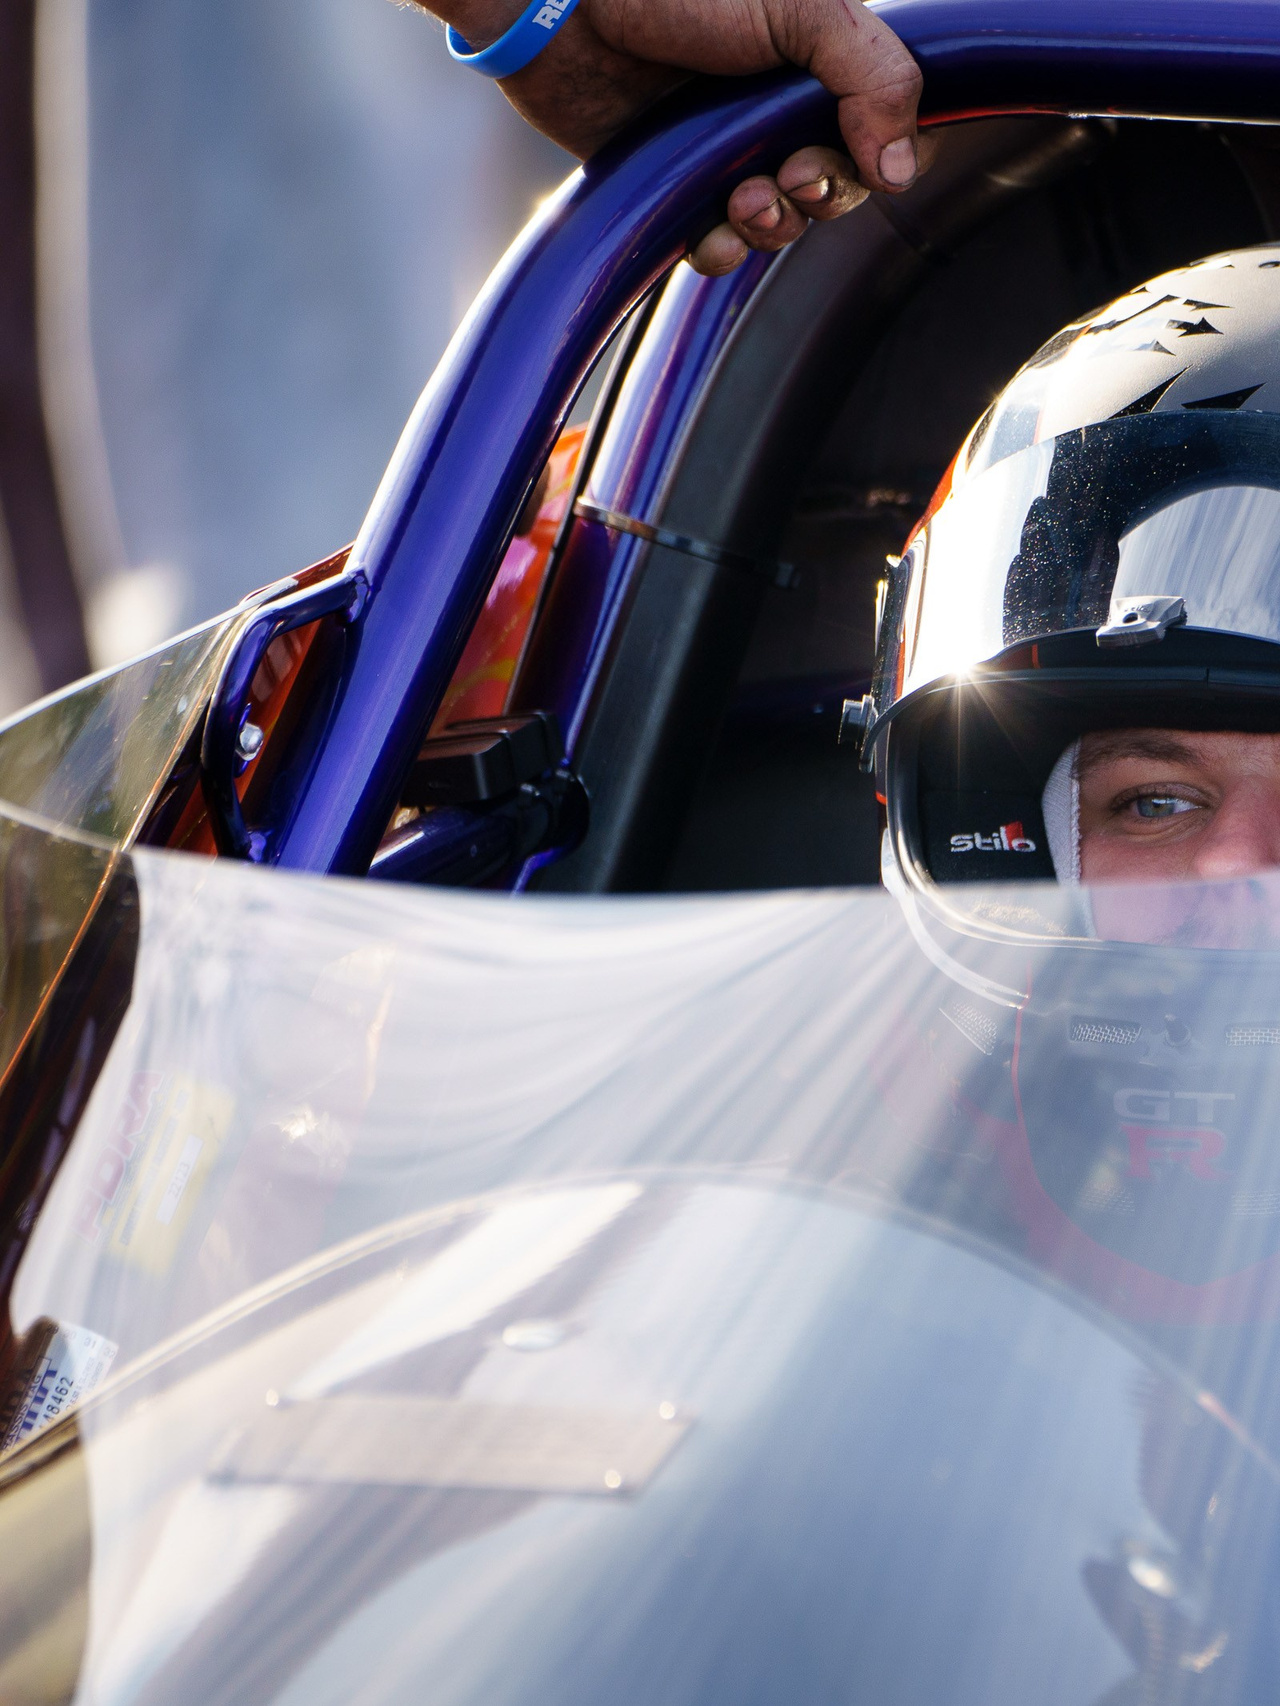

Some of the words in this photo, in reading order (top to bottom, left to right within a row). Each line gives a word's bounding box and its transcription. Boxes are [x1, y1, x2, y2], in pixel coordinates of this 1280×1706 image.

[1113, 1088, 1236, 1123] GT
[1119, 1122, 1231, 1182] R
[38, 1376, 74, 1429] 48462
